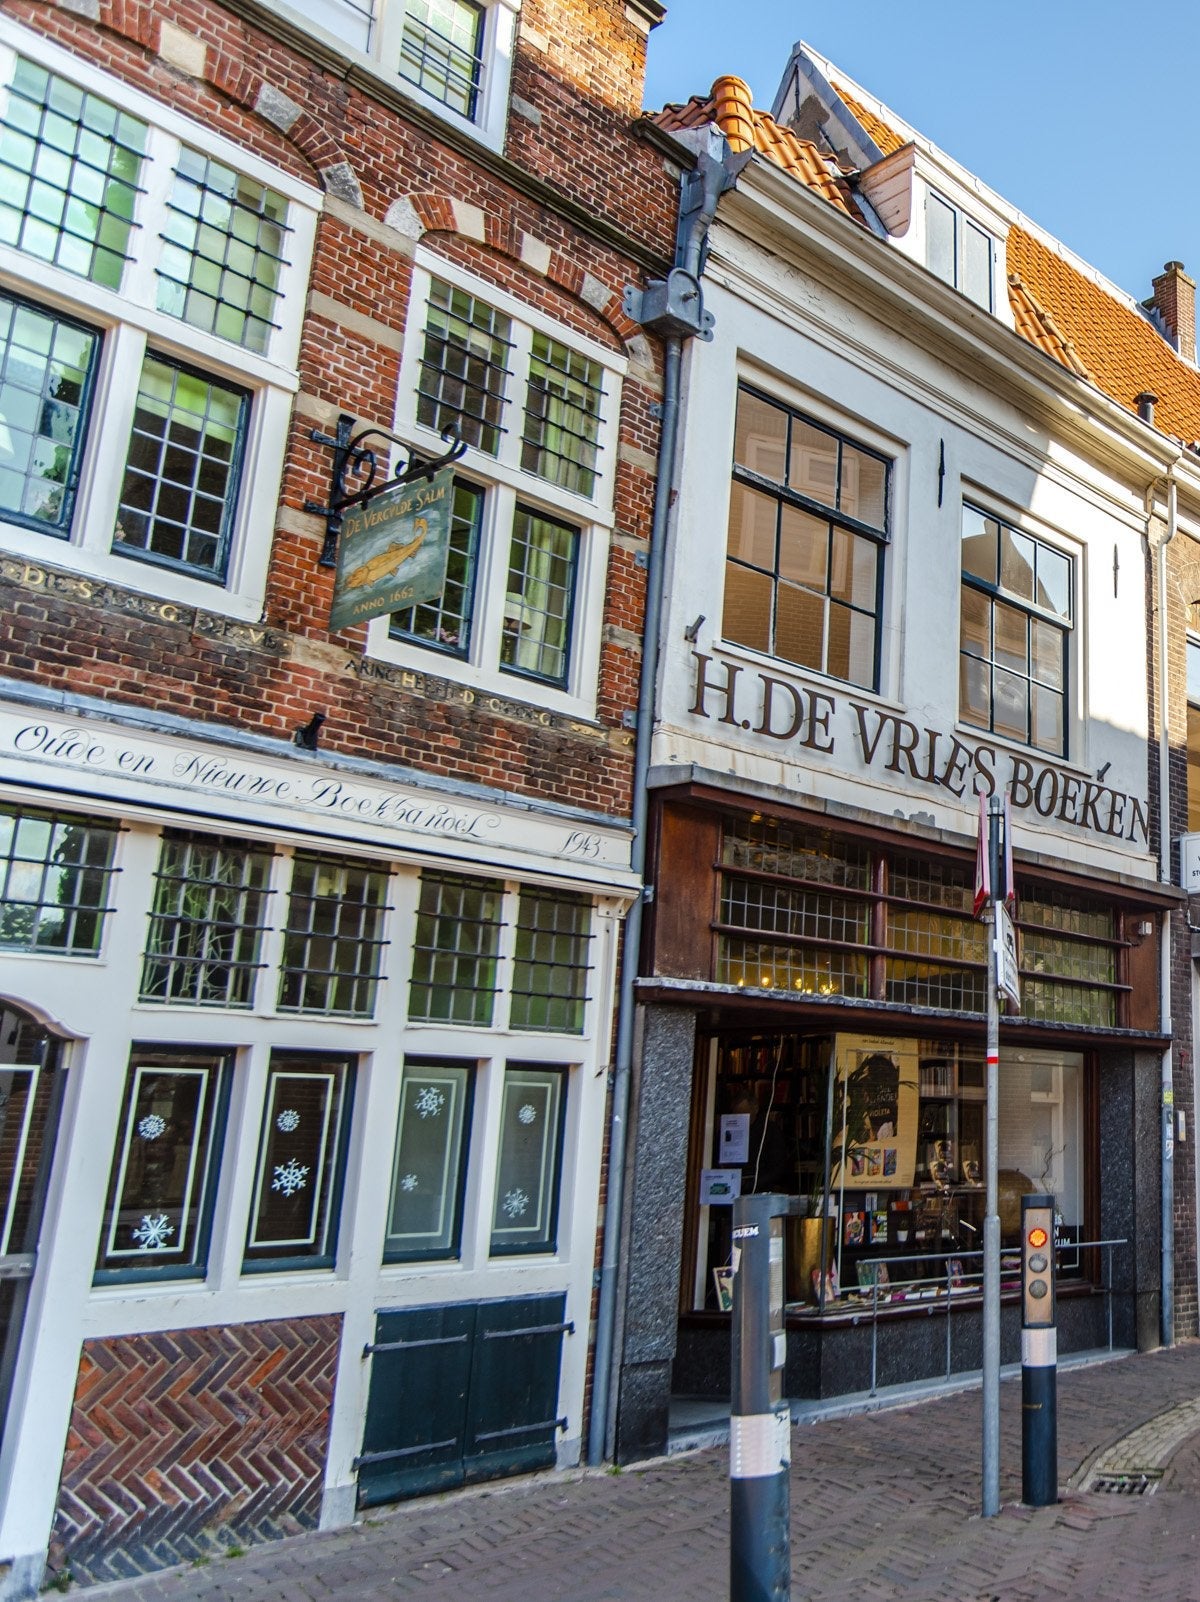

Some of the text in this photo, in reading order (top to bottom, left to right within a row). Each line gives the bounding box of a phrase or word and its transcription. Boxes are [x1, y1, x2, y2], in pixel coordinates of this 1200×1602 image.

[345, 519, 361, 538] DE
[415, 486, 446, 511] SALM
[352, 587, 415, 615] ANNO 1662
[14, 725, 106, 764] Oude
[118, 748, 158, 773] en
[849, 703, 996, 798] VRIES
[1008, 755, 1150, 846] BOEKEN
